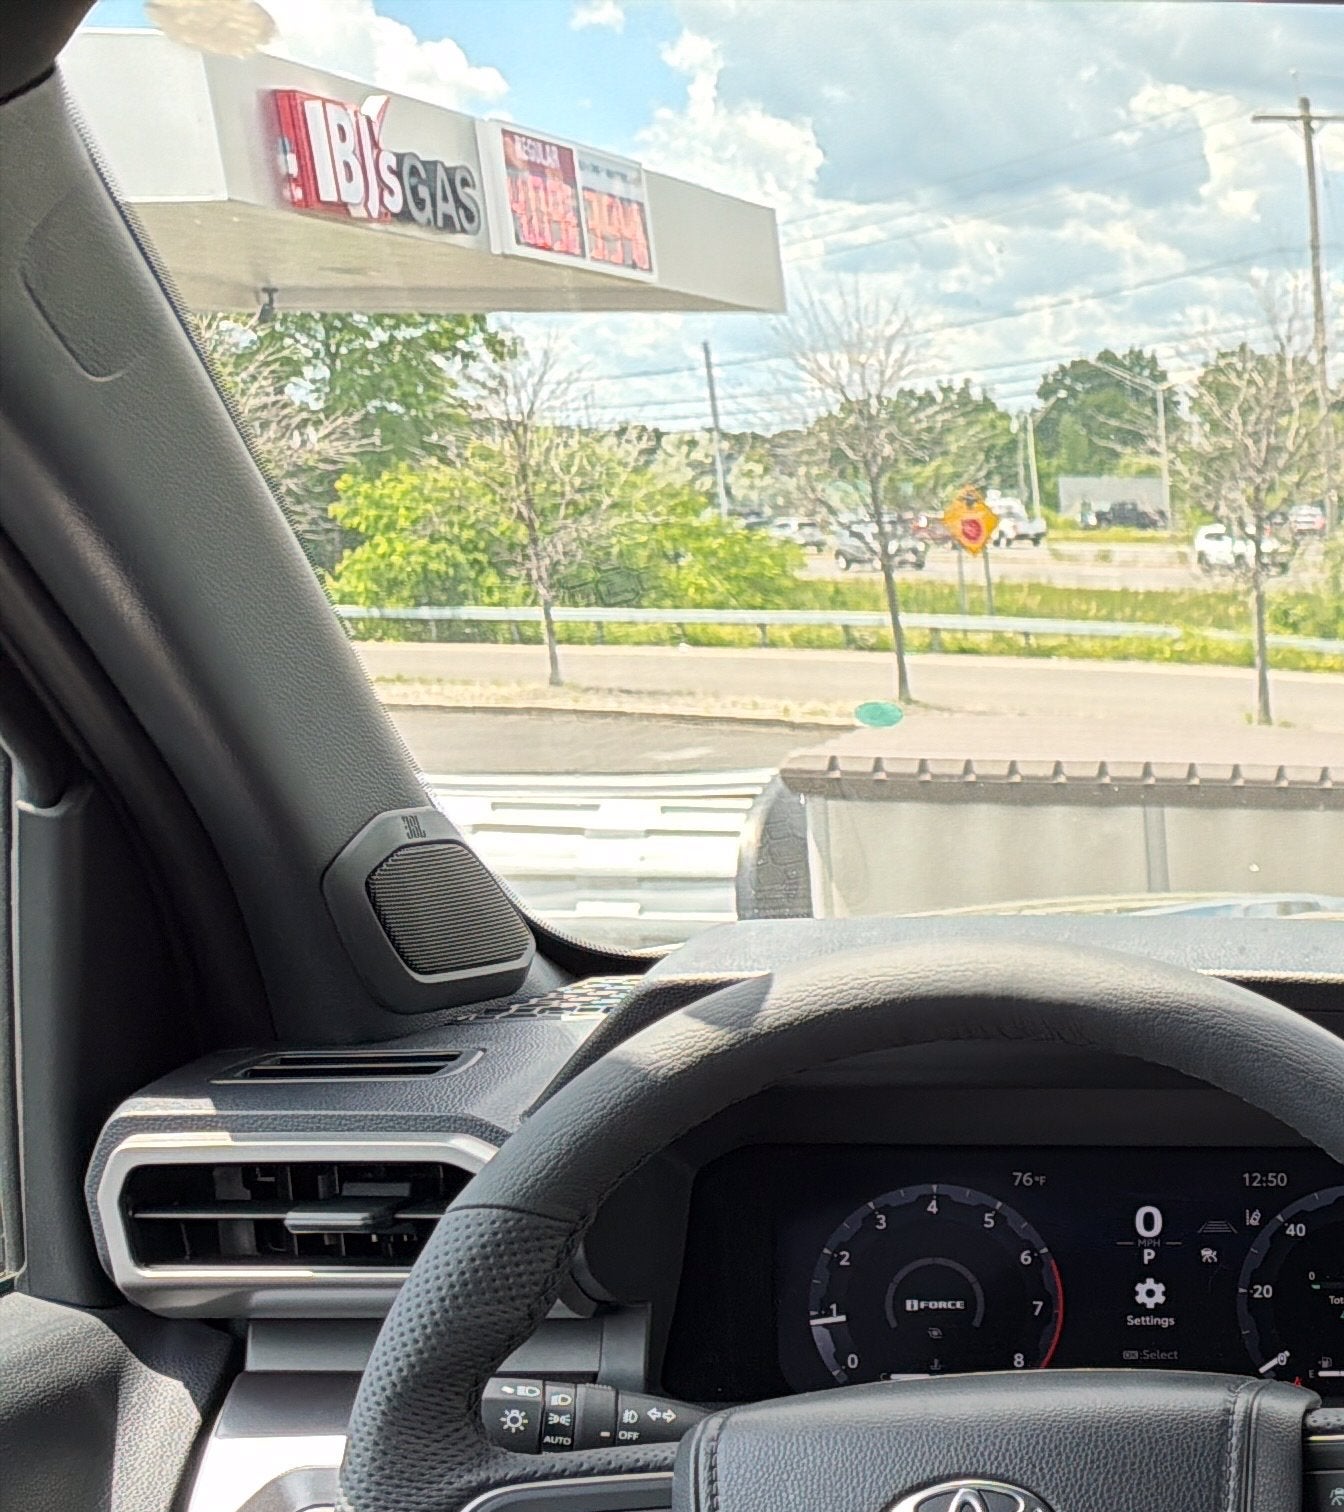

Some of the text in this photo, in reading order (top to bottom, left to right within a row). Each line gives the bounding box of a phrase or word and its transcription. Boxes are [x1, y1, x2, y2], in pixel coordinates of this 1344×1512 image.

[402, 150, 481, 236] GAS
[1242, 1172, 1288, 1188] 12:50
[926, 1199, 938, 1215] 4
[875, 1214, 888, 1230] 3
[983, 1212, 996, 1228] 5
[1134, 1205, 1163, 1238] 0
[1285, 1223, 1306, 1238] 40
[1137, 1238, 1161, 1248] MPH
[839, 1250, 850, 1266] 2
[1020, 1250, 1032, 1265] 6
[1143, 1249, 1156, 1265] P
[1253, 1284, 1273, 1299] 20
[828, 1302, 838, 1317] 1
[1032, 1301, 1044, 1316] 7
[1126, 1315, 1175, 1328] Settings
[847, 1354, 859, 1369] 0
[1013, 1353, 1025, 1369] 8
[1277, 1352, 1288, 1367] 0
[543, 1435, 572, 1446] AUTO
[618, 1430, 640, 1441] OFF
